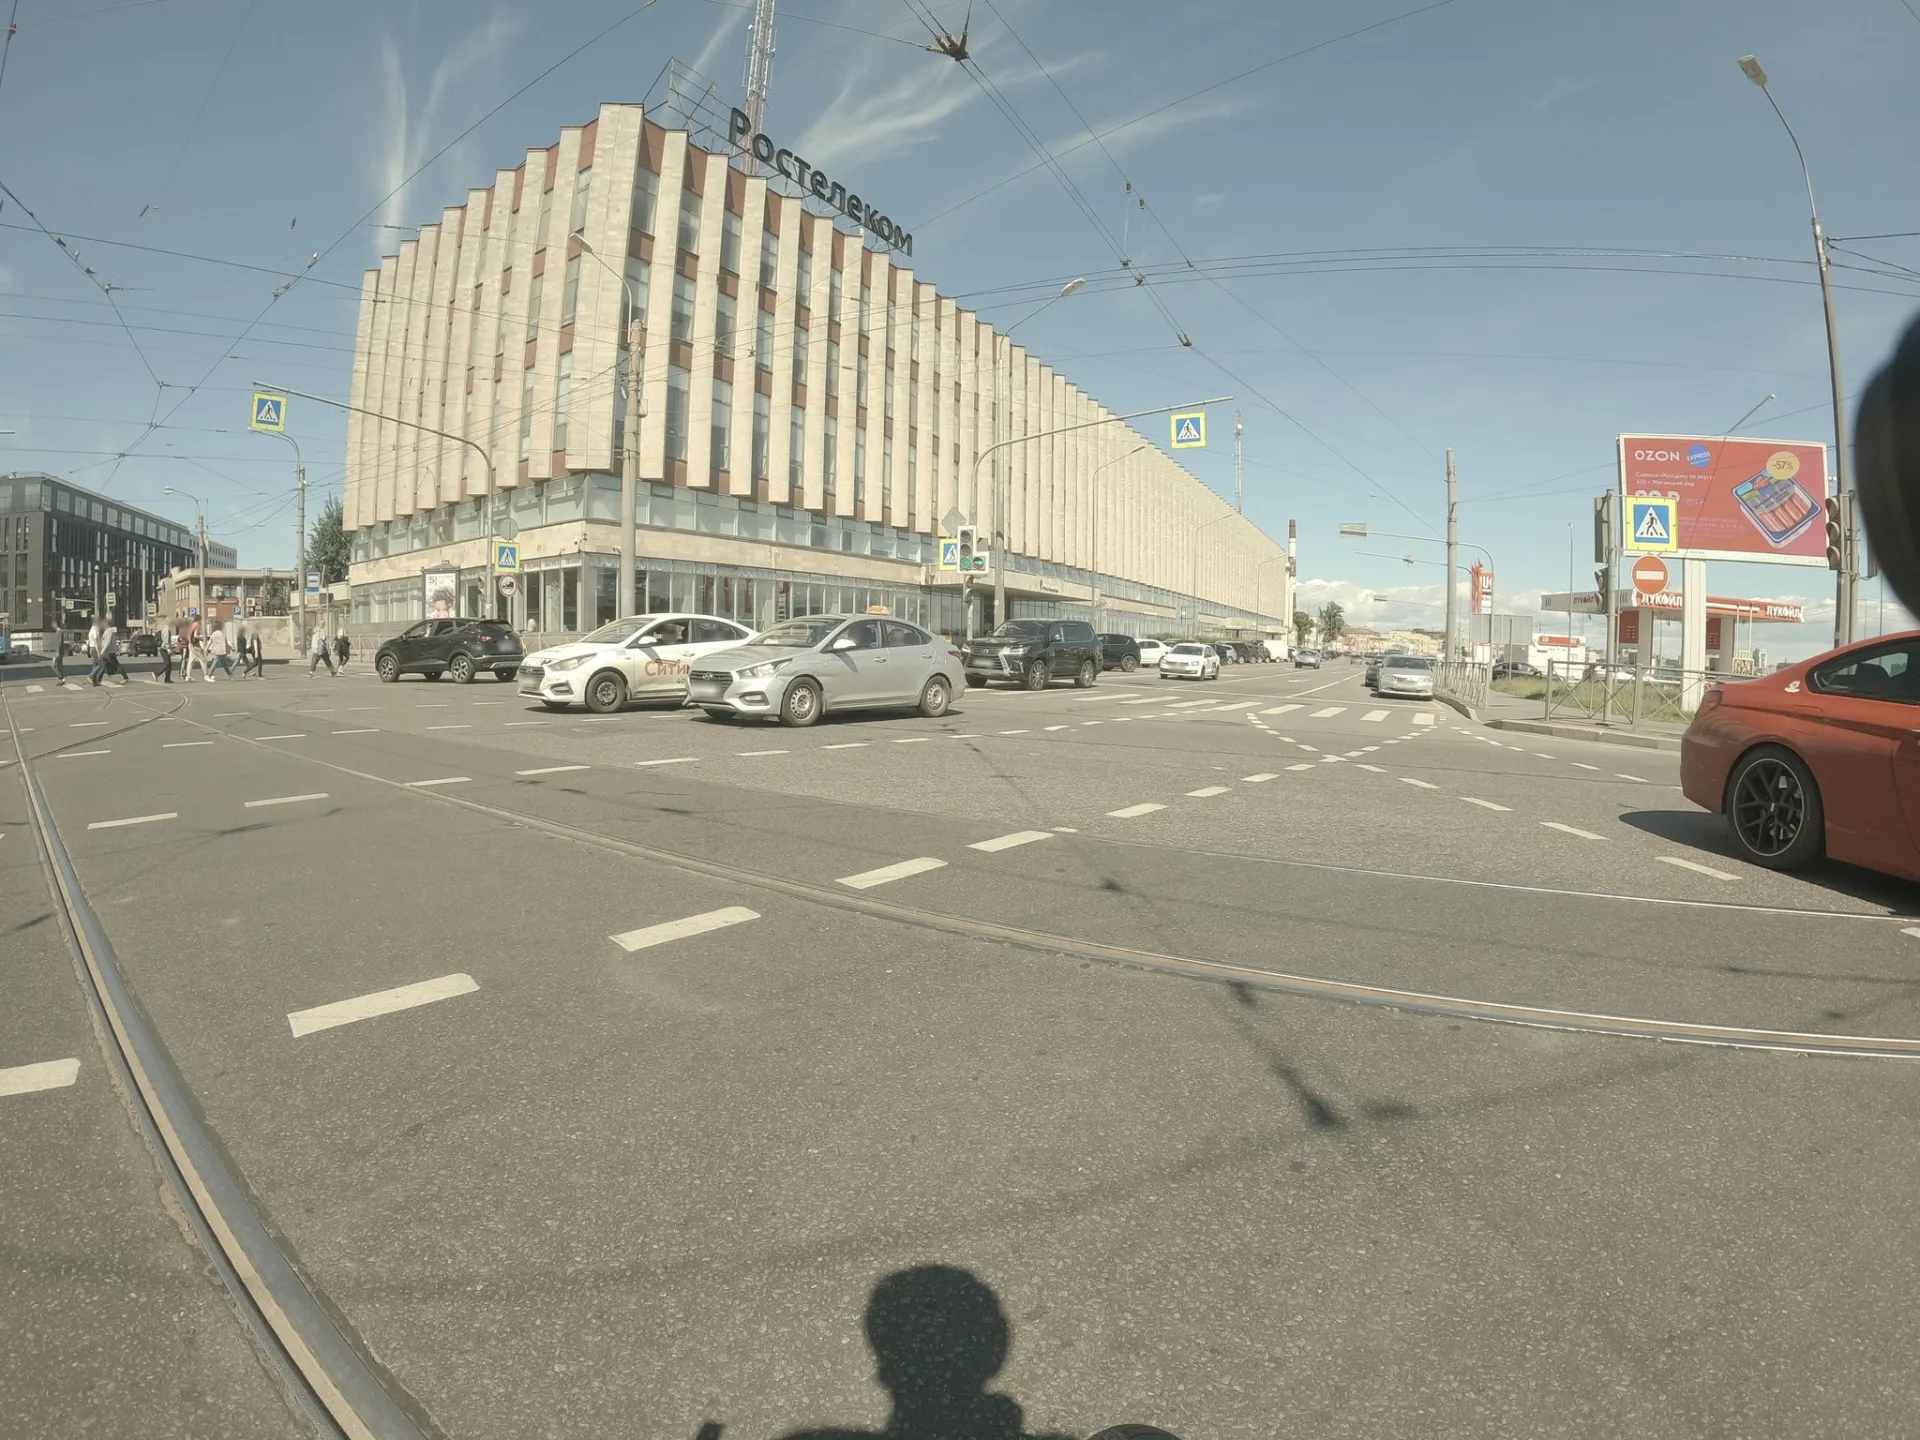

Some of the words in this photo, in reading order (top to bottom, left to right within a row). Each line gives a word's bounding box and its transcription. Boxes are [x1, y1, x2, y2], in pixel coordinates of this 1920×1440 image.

[729, 107, 913, 257] Ростелеком
[1634, 450, 1680, 461] OZON
[1772, 460, 1794, 470] -57%
[1641, 593, 1683, 608] ЛУКОЙЛ
[1766, 605, 1800, 619] ЛУКОЙЛ
